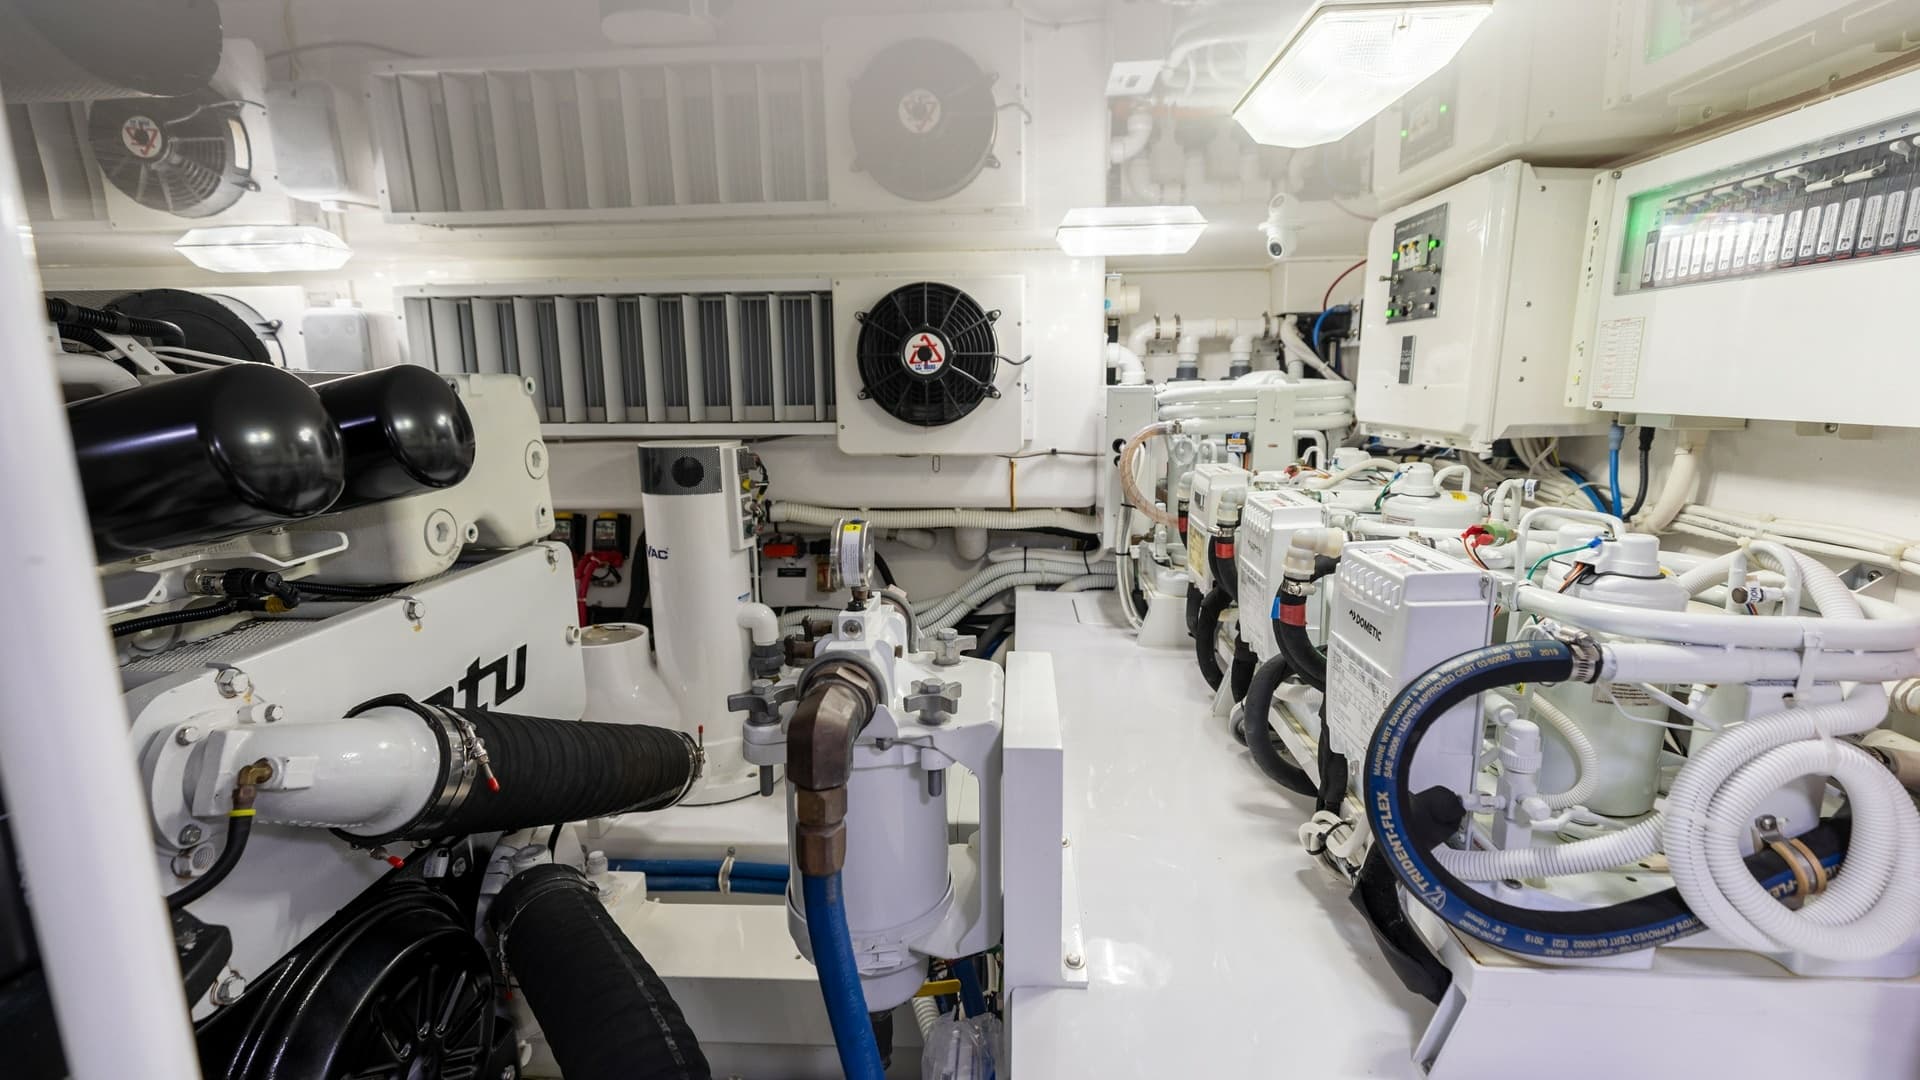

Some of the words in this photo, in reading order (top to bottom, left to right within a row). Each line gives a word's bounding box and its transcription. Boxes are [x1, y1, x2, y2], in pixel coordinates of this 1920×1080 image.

[1356, 614, 1382, 642] DOMETIC
[1373, 741, 1386, 776] MARINE
[1380, 726, 1393, 744] WET
[1390, 696, 1416, 727] EXHAUST
[1383, 760, 1393, 779] SAE
[1399, 703, 1421, 733] LLOYD'S
[1420, 674, 1456, 707] APPROVED
[1454, 664, 1477, 678] CERT
[1376, 791, 1430, 893] TRIDENT-FLEX
[1609, 934, 1632, 946] CERT
[1632, 924, 1676, 942] APPROVED
